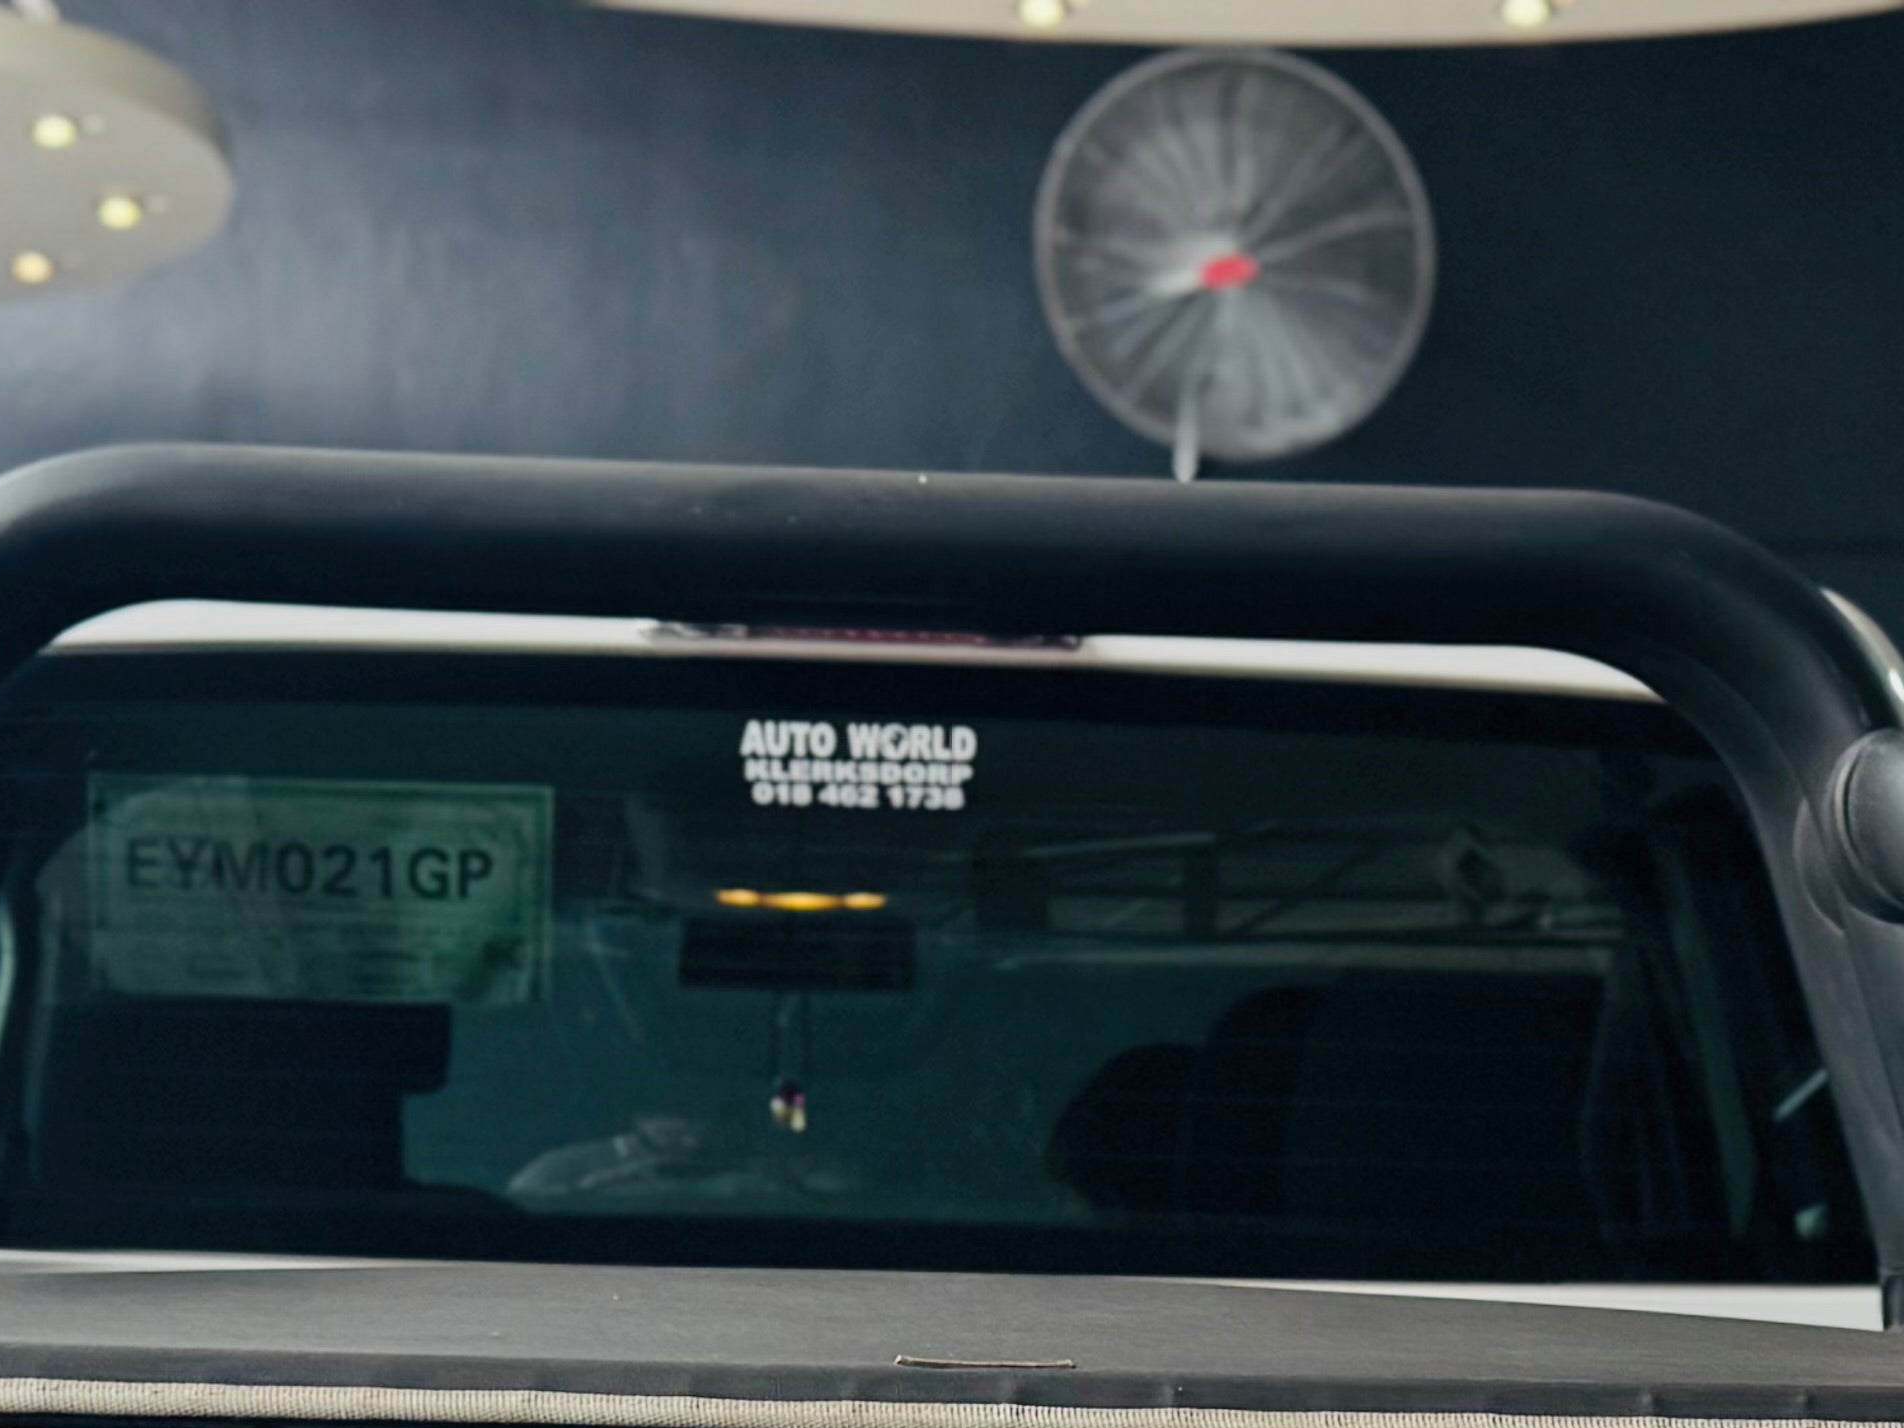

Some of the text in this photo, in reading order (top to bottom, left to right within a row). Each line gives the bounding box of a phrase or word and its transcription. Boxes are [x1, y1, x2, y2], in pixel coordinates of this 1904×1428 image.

[740, 719, 977, 762] AUTO WORLD
[743, 757, 974, 786] KLERKSDORP
[751, 781, 813, 806] 018
